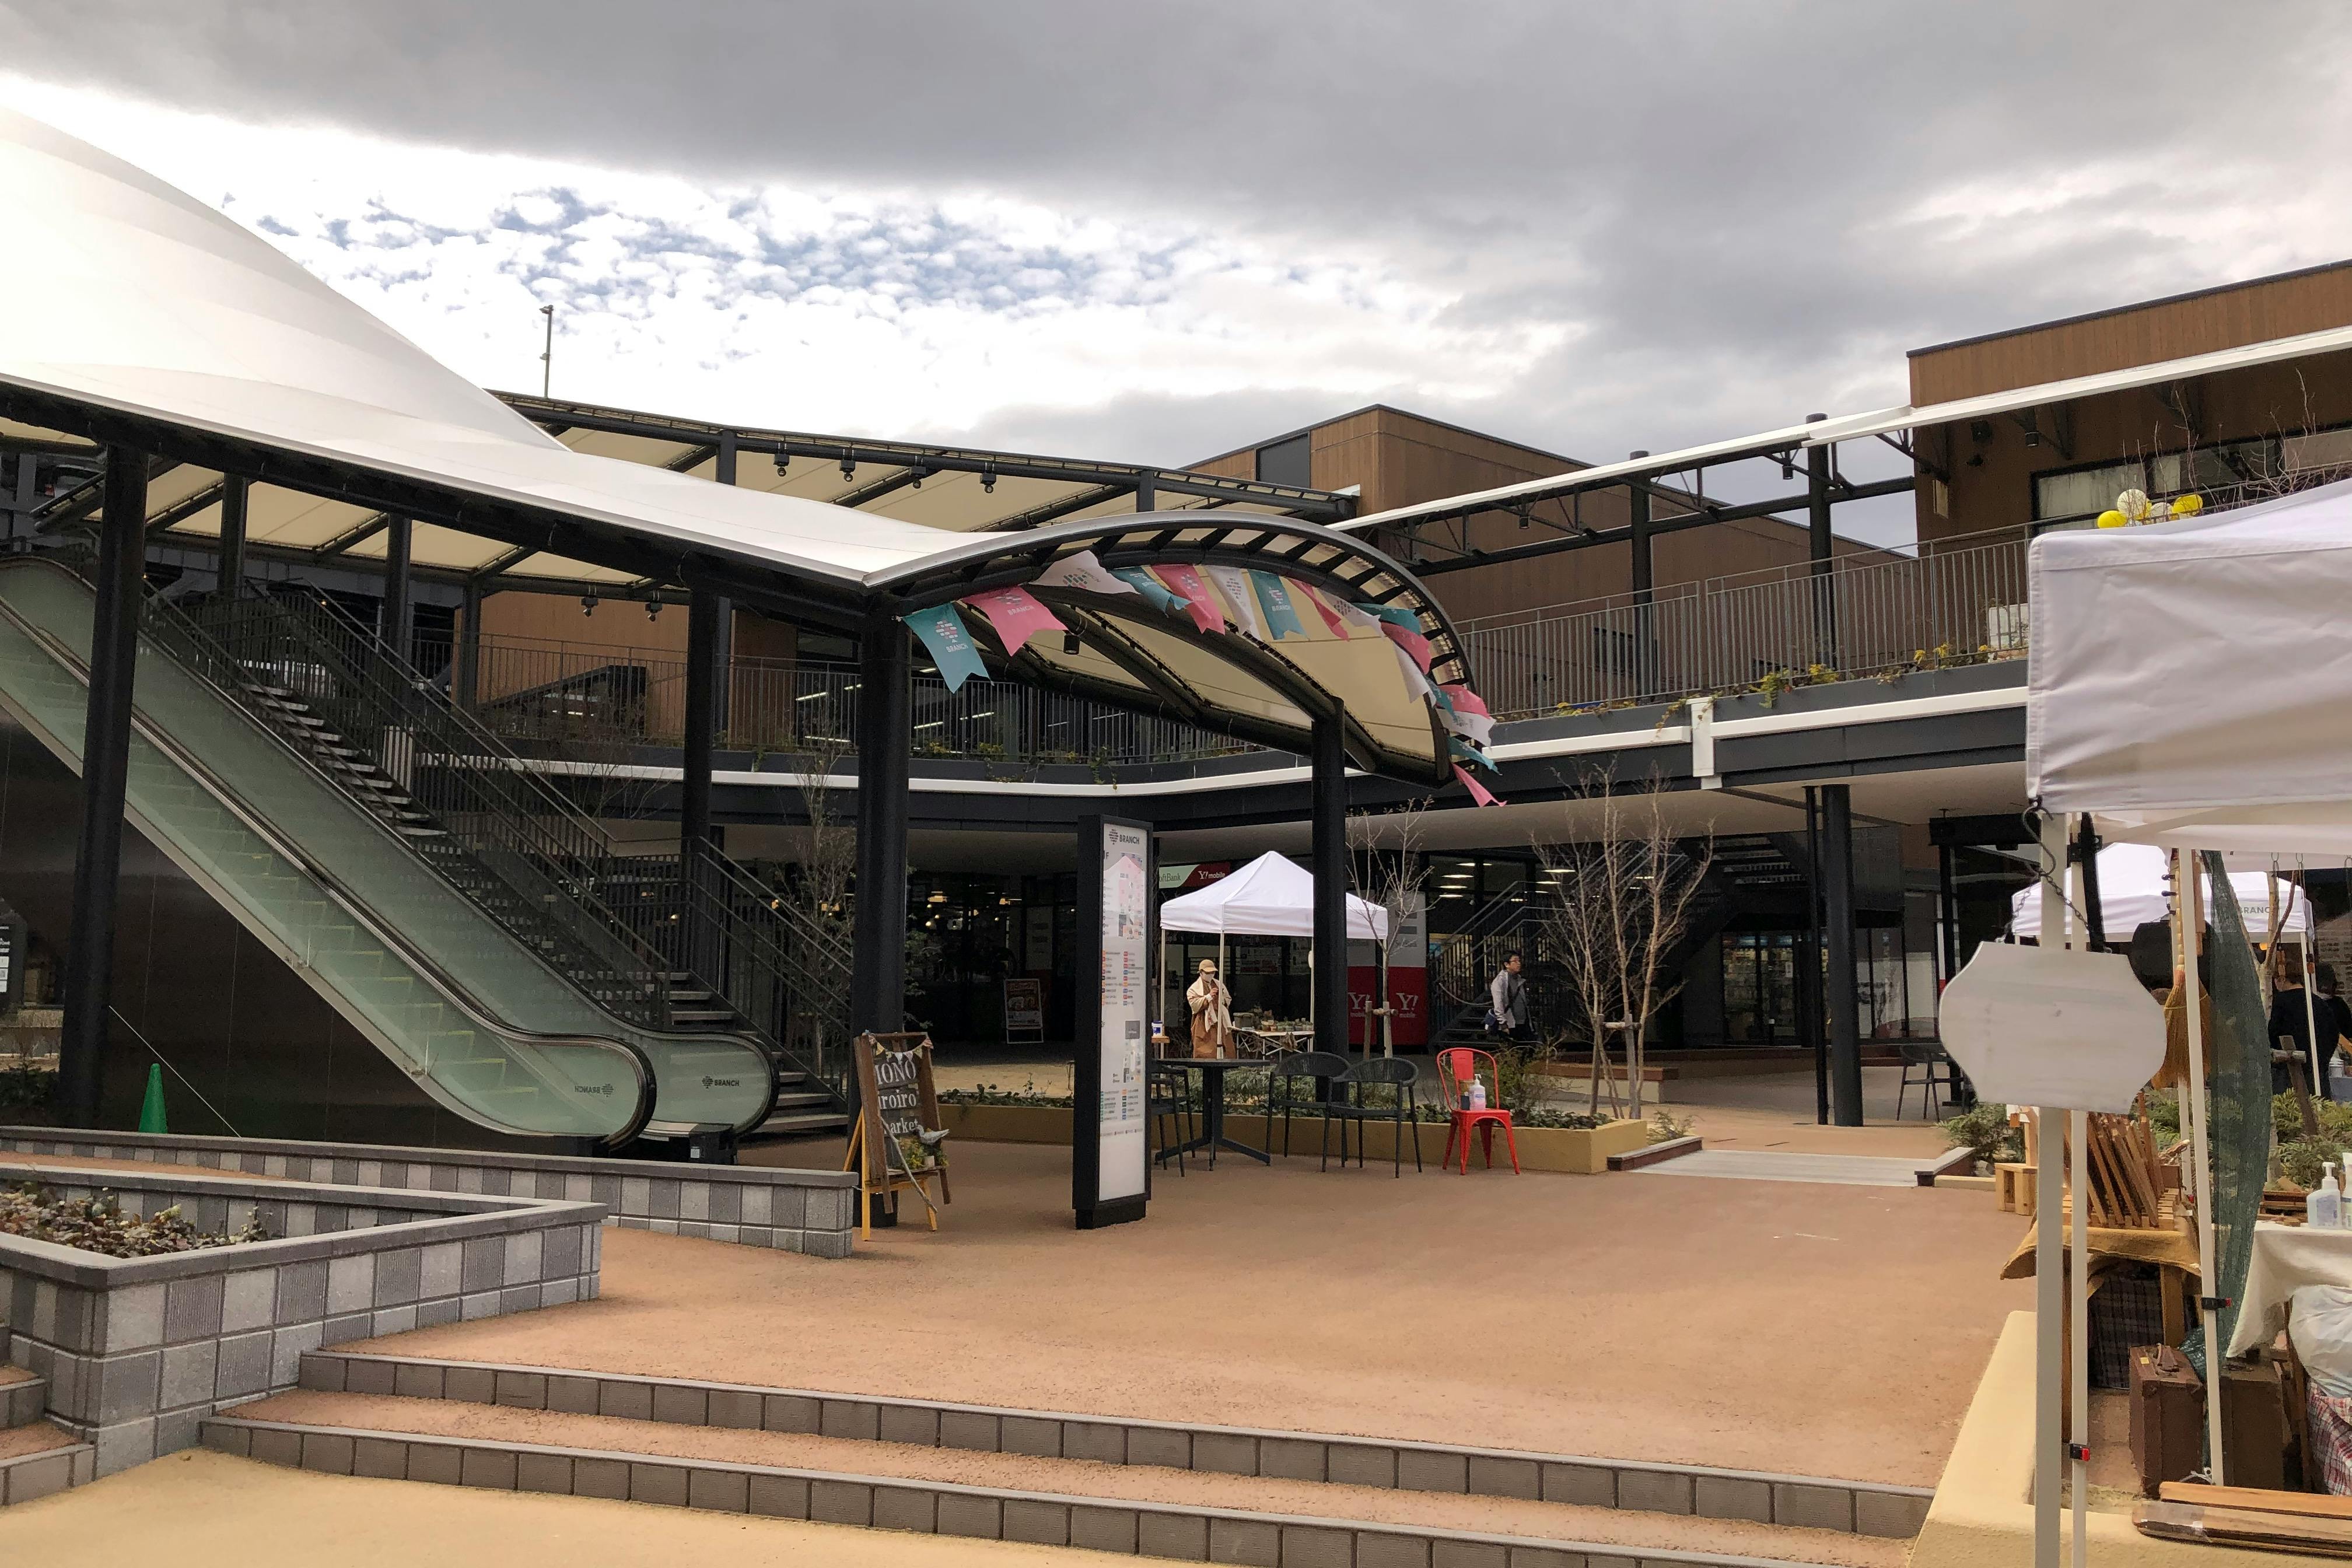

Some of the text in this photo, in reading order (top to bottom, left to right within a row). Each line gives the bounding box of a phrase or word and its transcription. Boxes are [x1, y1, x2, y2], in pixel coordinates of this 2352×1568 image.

[1007, 605, 1034, 616] BRANCH
[946, 643, 968, 653] BRANCH
[1119, 834, 1140, 844] BRANCH
[1159, 873, 1181, 882] oftBank
[2239, 906, 2270, 914] RANC
[1396, 993, 1418, 1010] Y!
